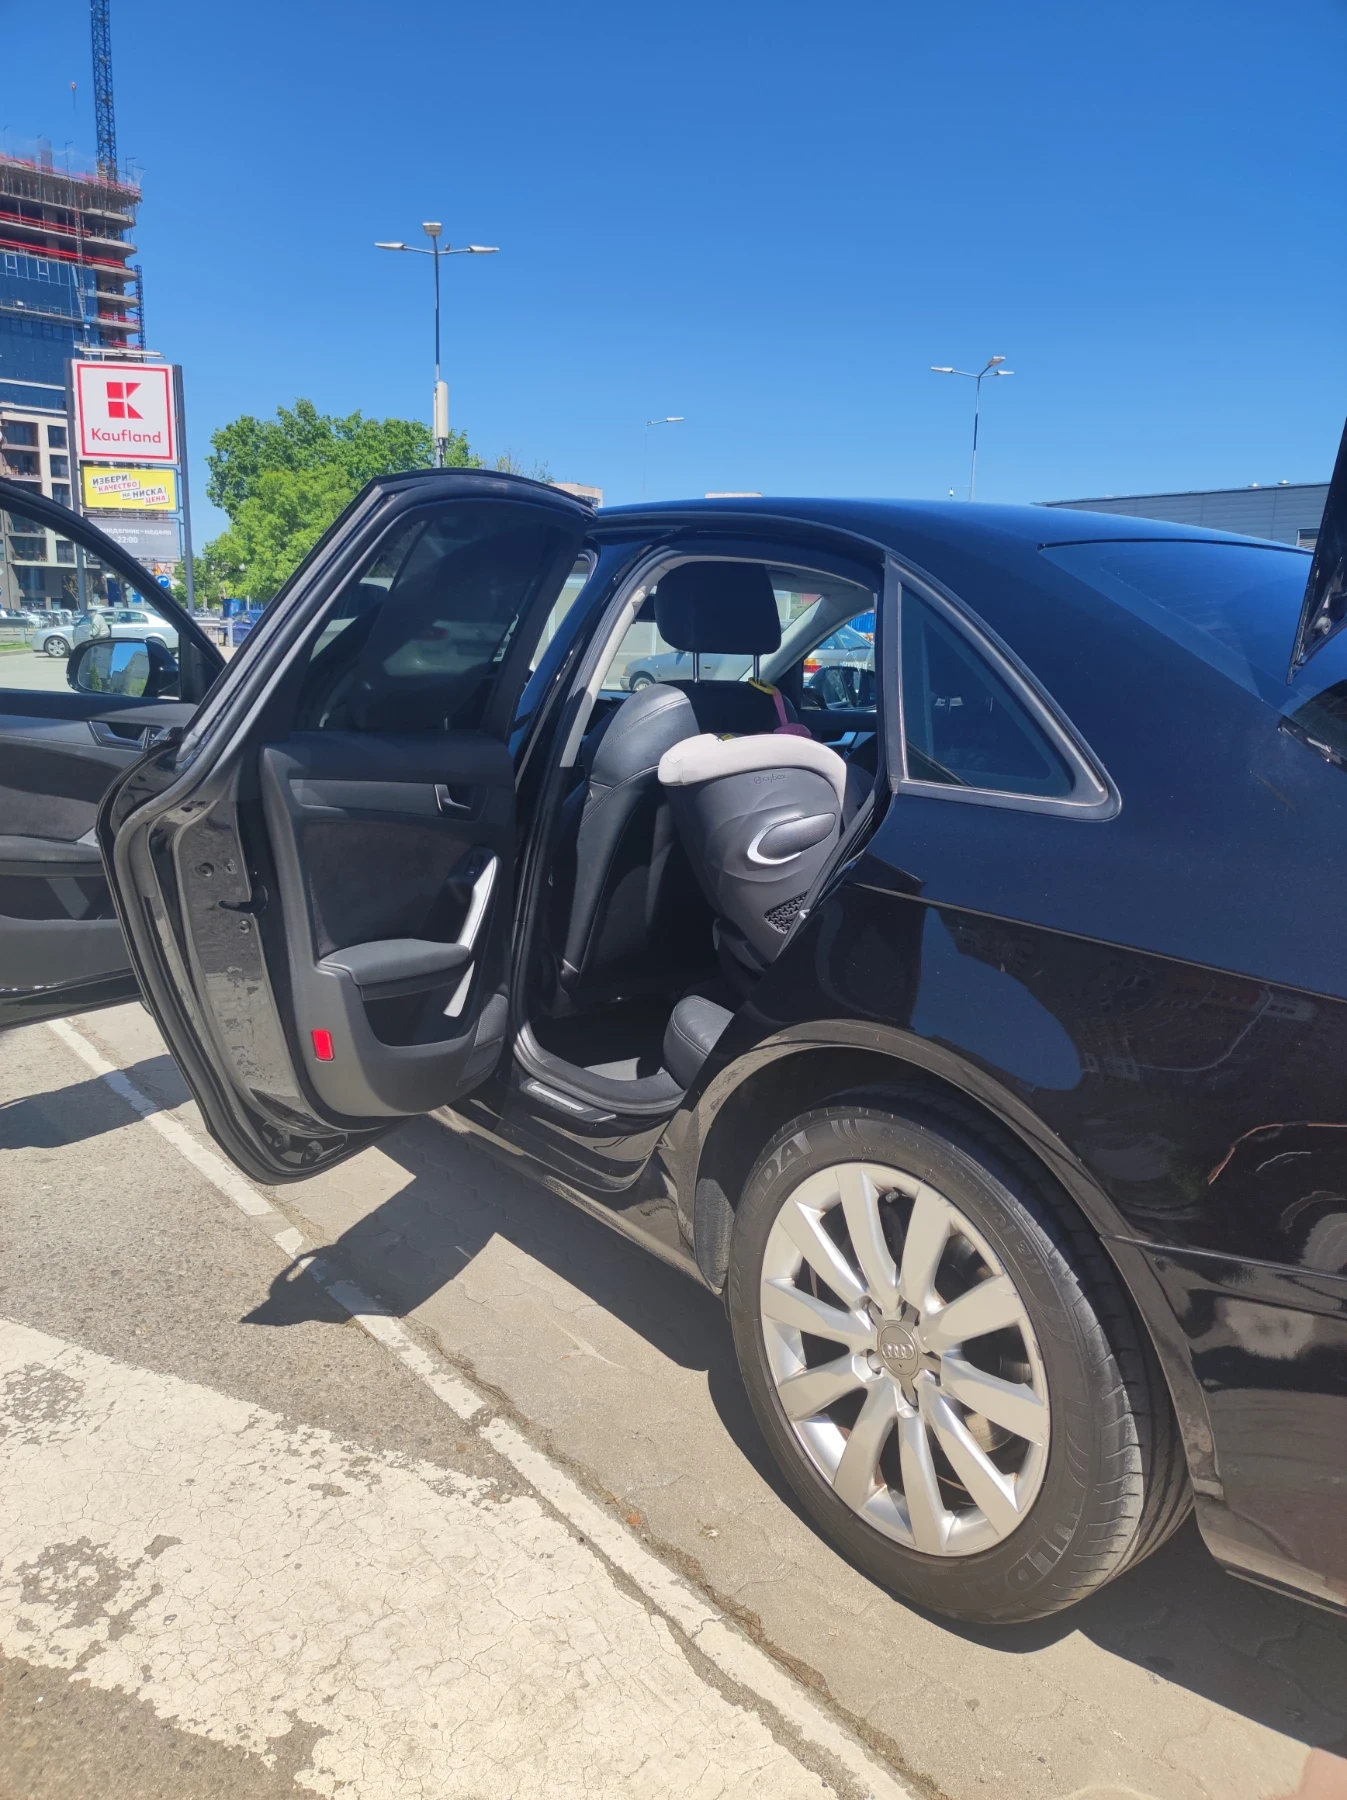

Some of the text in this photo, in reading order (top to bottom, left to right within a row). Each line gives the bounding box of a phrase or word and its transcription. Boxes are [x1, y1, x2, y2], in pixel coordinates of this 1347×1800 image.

[91, 427, 162, 444] Kaufland
[92, 474, 128, 486] ИЗБЕРИ
[98, 481, 138, 492] КАЧЕСТВО
[132, 487, 163, 498] НИСКА
[145, 495, 166, 504] ЦЕНА
[762, 773, 787, 784] cybex
